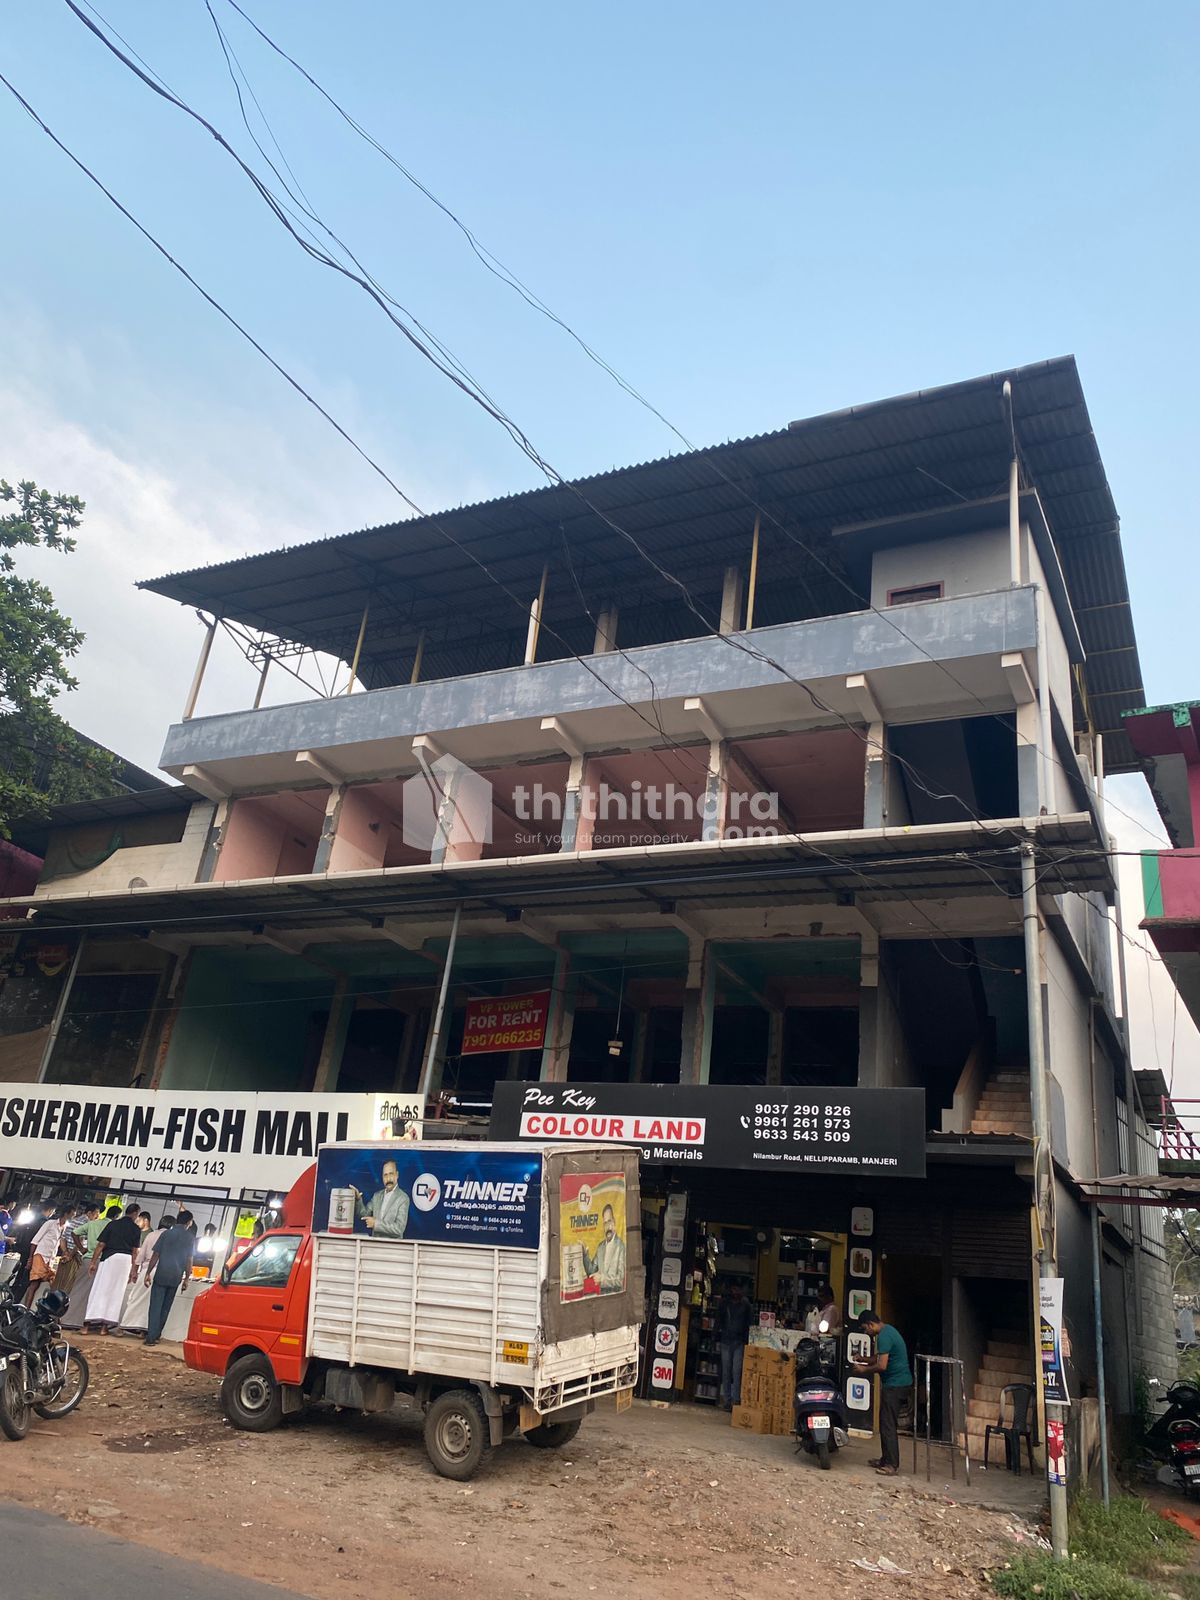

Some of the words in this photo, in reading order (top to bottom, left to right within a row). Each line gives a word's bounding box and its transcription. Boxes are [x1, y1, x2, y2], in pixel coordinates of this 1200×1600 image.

[495, 999, 534, 1012] TOWER
[468, 1014, 497, 1030] FOR
[501, 1009, 542, 1026] RENT
[524, 1088, 554, 1106] Pee
[562, 1089, 596, 1110] Key
[755, 1104, 789, 1115] 9037
[793, 1105, 819, 1115] 290
[824, 1106, 851, 1117] 826
[0, 1098, 246, 1153] SHERMAN-FISH
[527, 1116, 624, 1138] COLOUR
[633, 1120, 701, 1141] LAND
[754, 1117, 787, 1127] 9961
[793, 1118, 818, 1128] 261
[824, 1119, 851, 1130] 973
[754, 1129, 788, 1140] 9633
[792, 1130, 819, 1141] 543
[824, 1132, 851, 1143] 509
[653, 1147, 703, 1160] Materials
[753, 1152, 782, 1161] Nilambur
[784, 1154, 802, 1162] Road,
[862, 1157, 898, 1166] MANJERI
[75, 1150, 140, 1170] 8943771700
[146, 1157, 174, 1173] 9744
[177, 1159, 199, 1175] 562
[203, 1161, 225, 1176] 143
[443, 1180, 528, 1203] THINNER
[570, 1213, 598, 1229] THINNER
[654, 1366, 672, 1380] 3M
